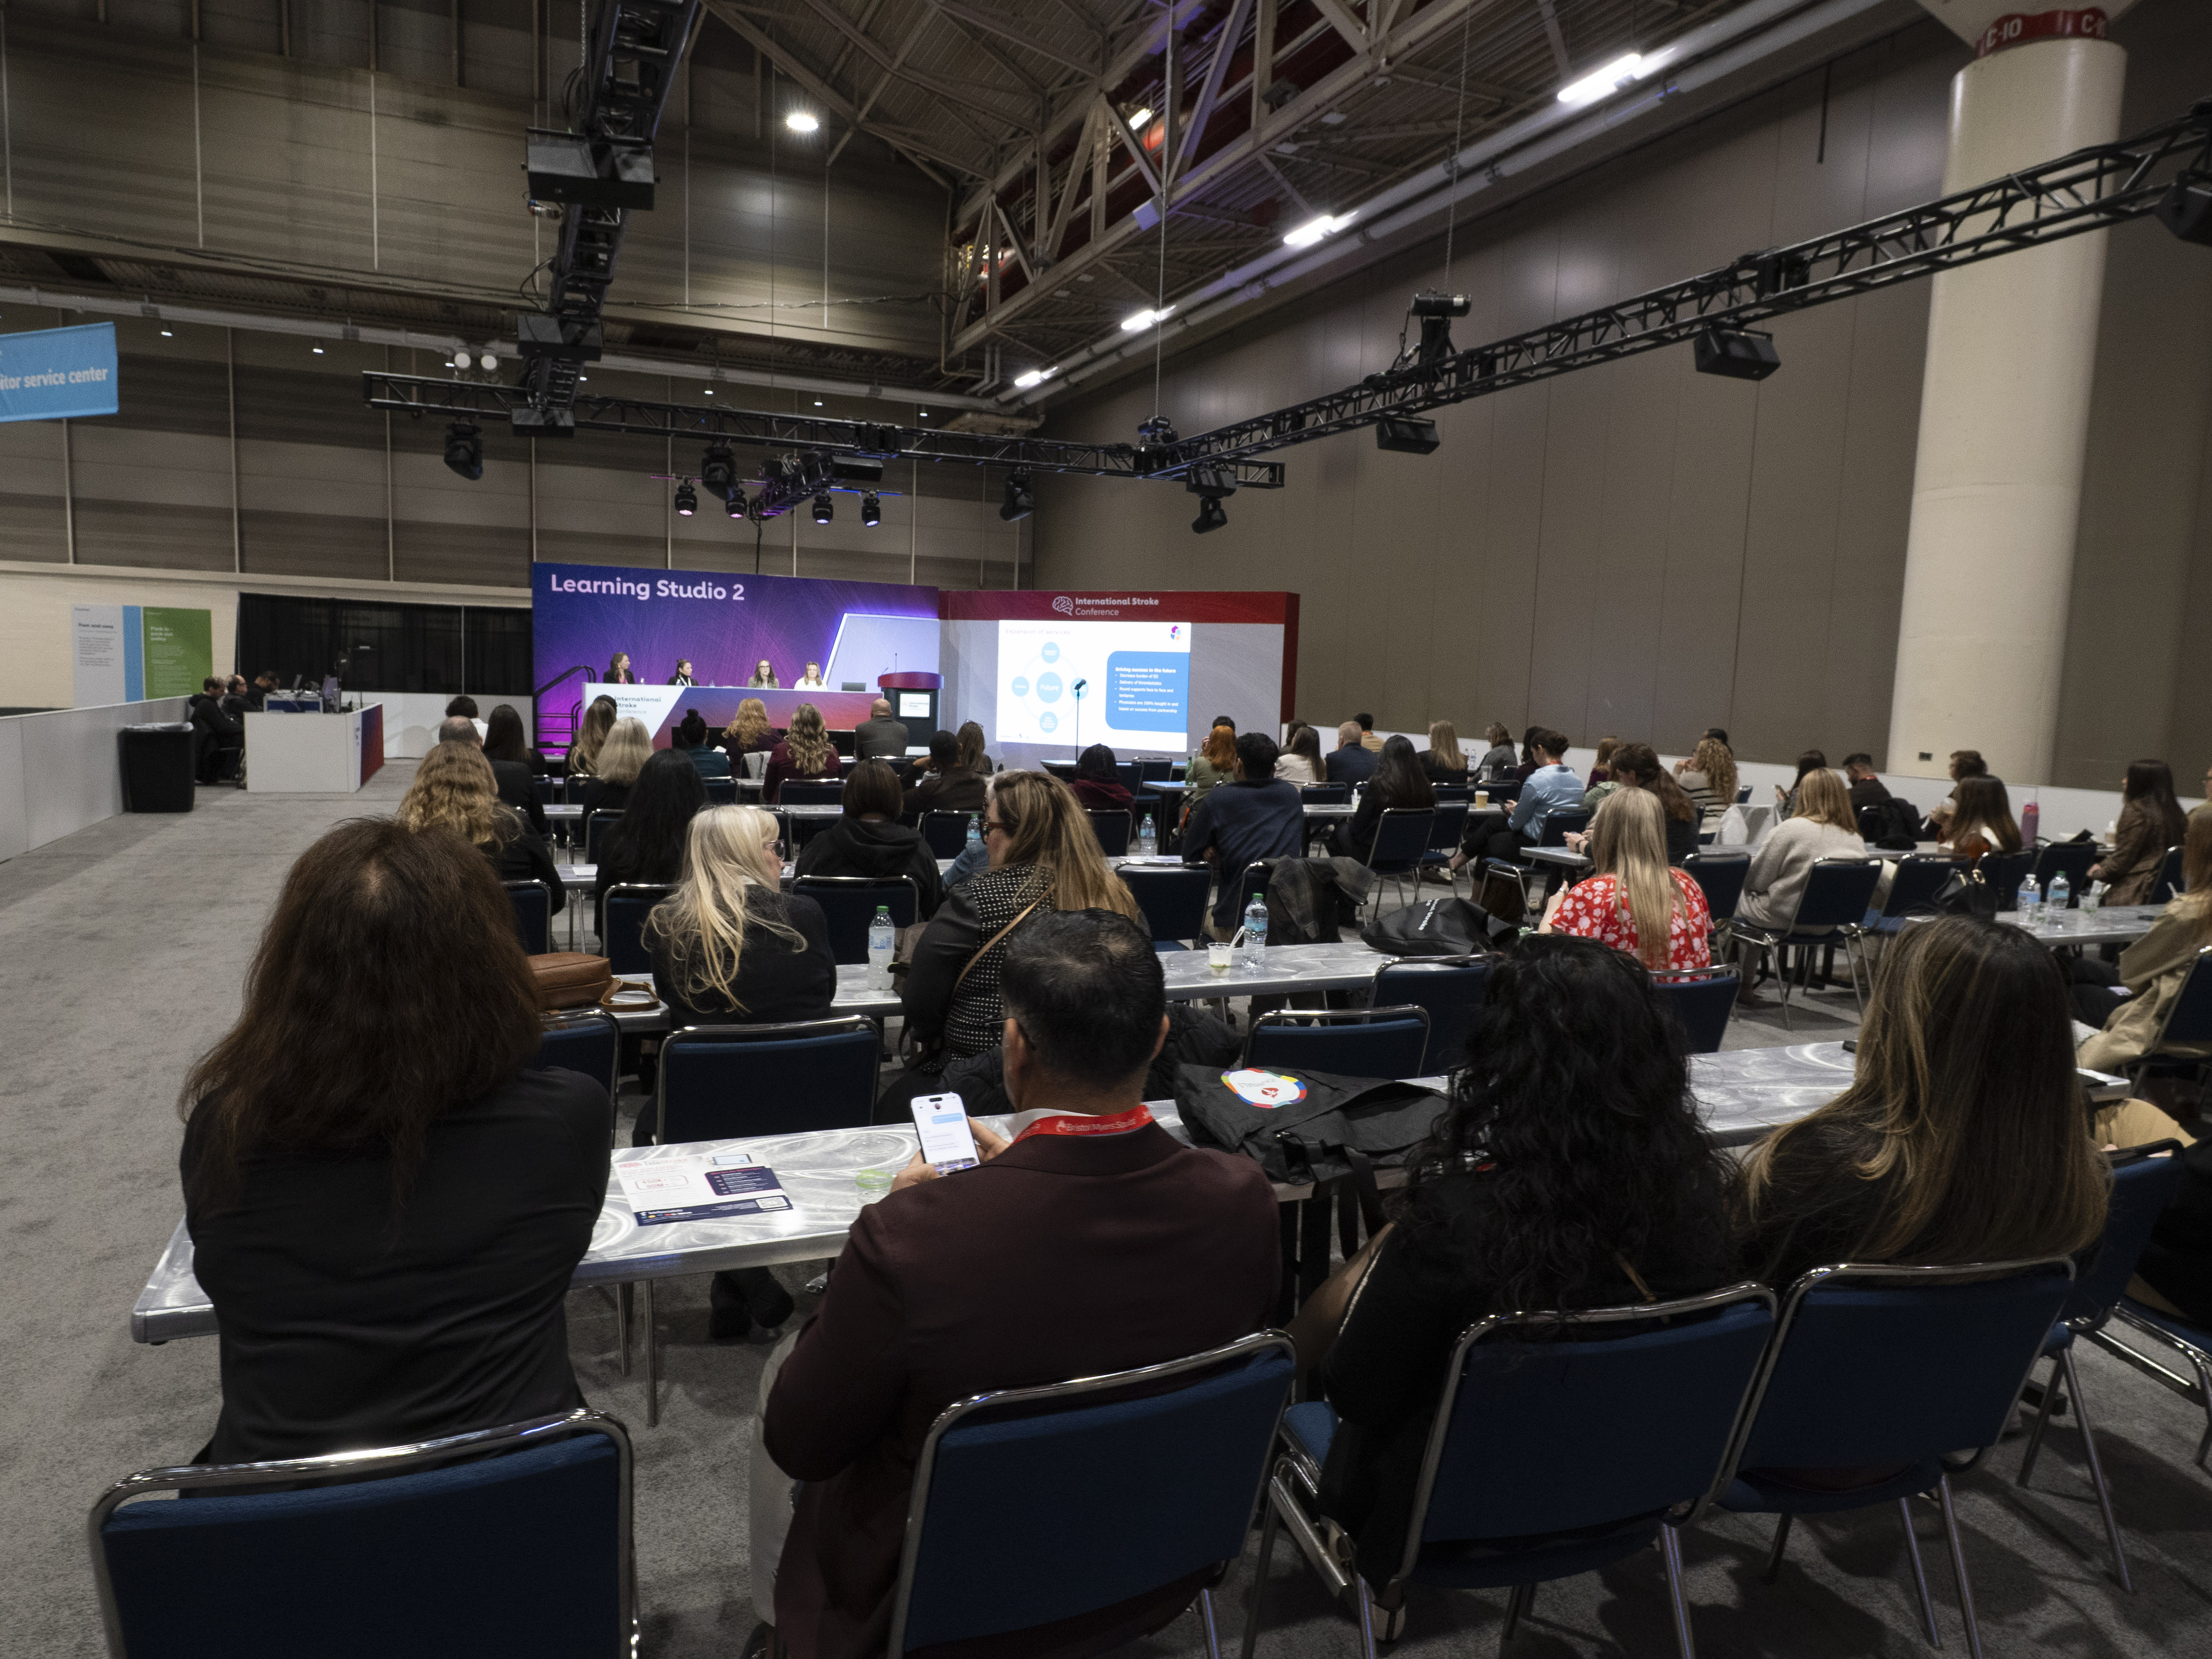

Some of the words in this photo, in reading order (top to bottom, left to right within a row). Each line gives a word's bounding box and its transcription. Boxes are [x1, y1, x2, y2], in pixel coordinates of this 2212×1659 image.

[1986, 17, 2022, 47] C-10
[24, 368, 66, 388] service
[68, 367, 108, 384] center
[551, 574, 650, 600] Learning
[657, 579, 726, 600] Studio
[732, 584, 745, 600] 2
[1075, 608, 1119, 616] Conference
[1238, 1079, 1277, 1088] JOURNALS
